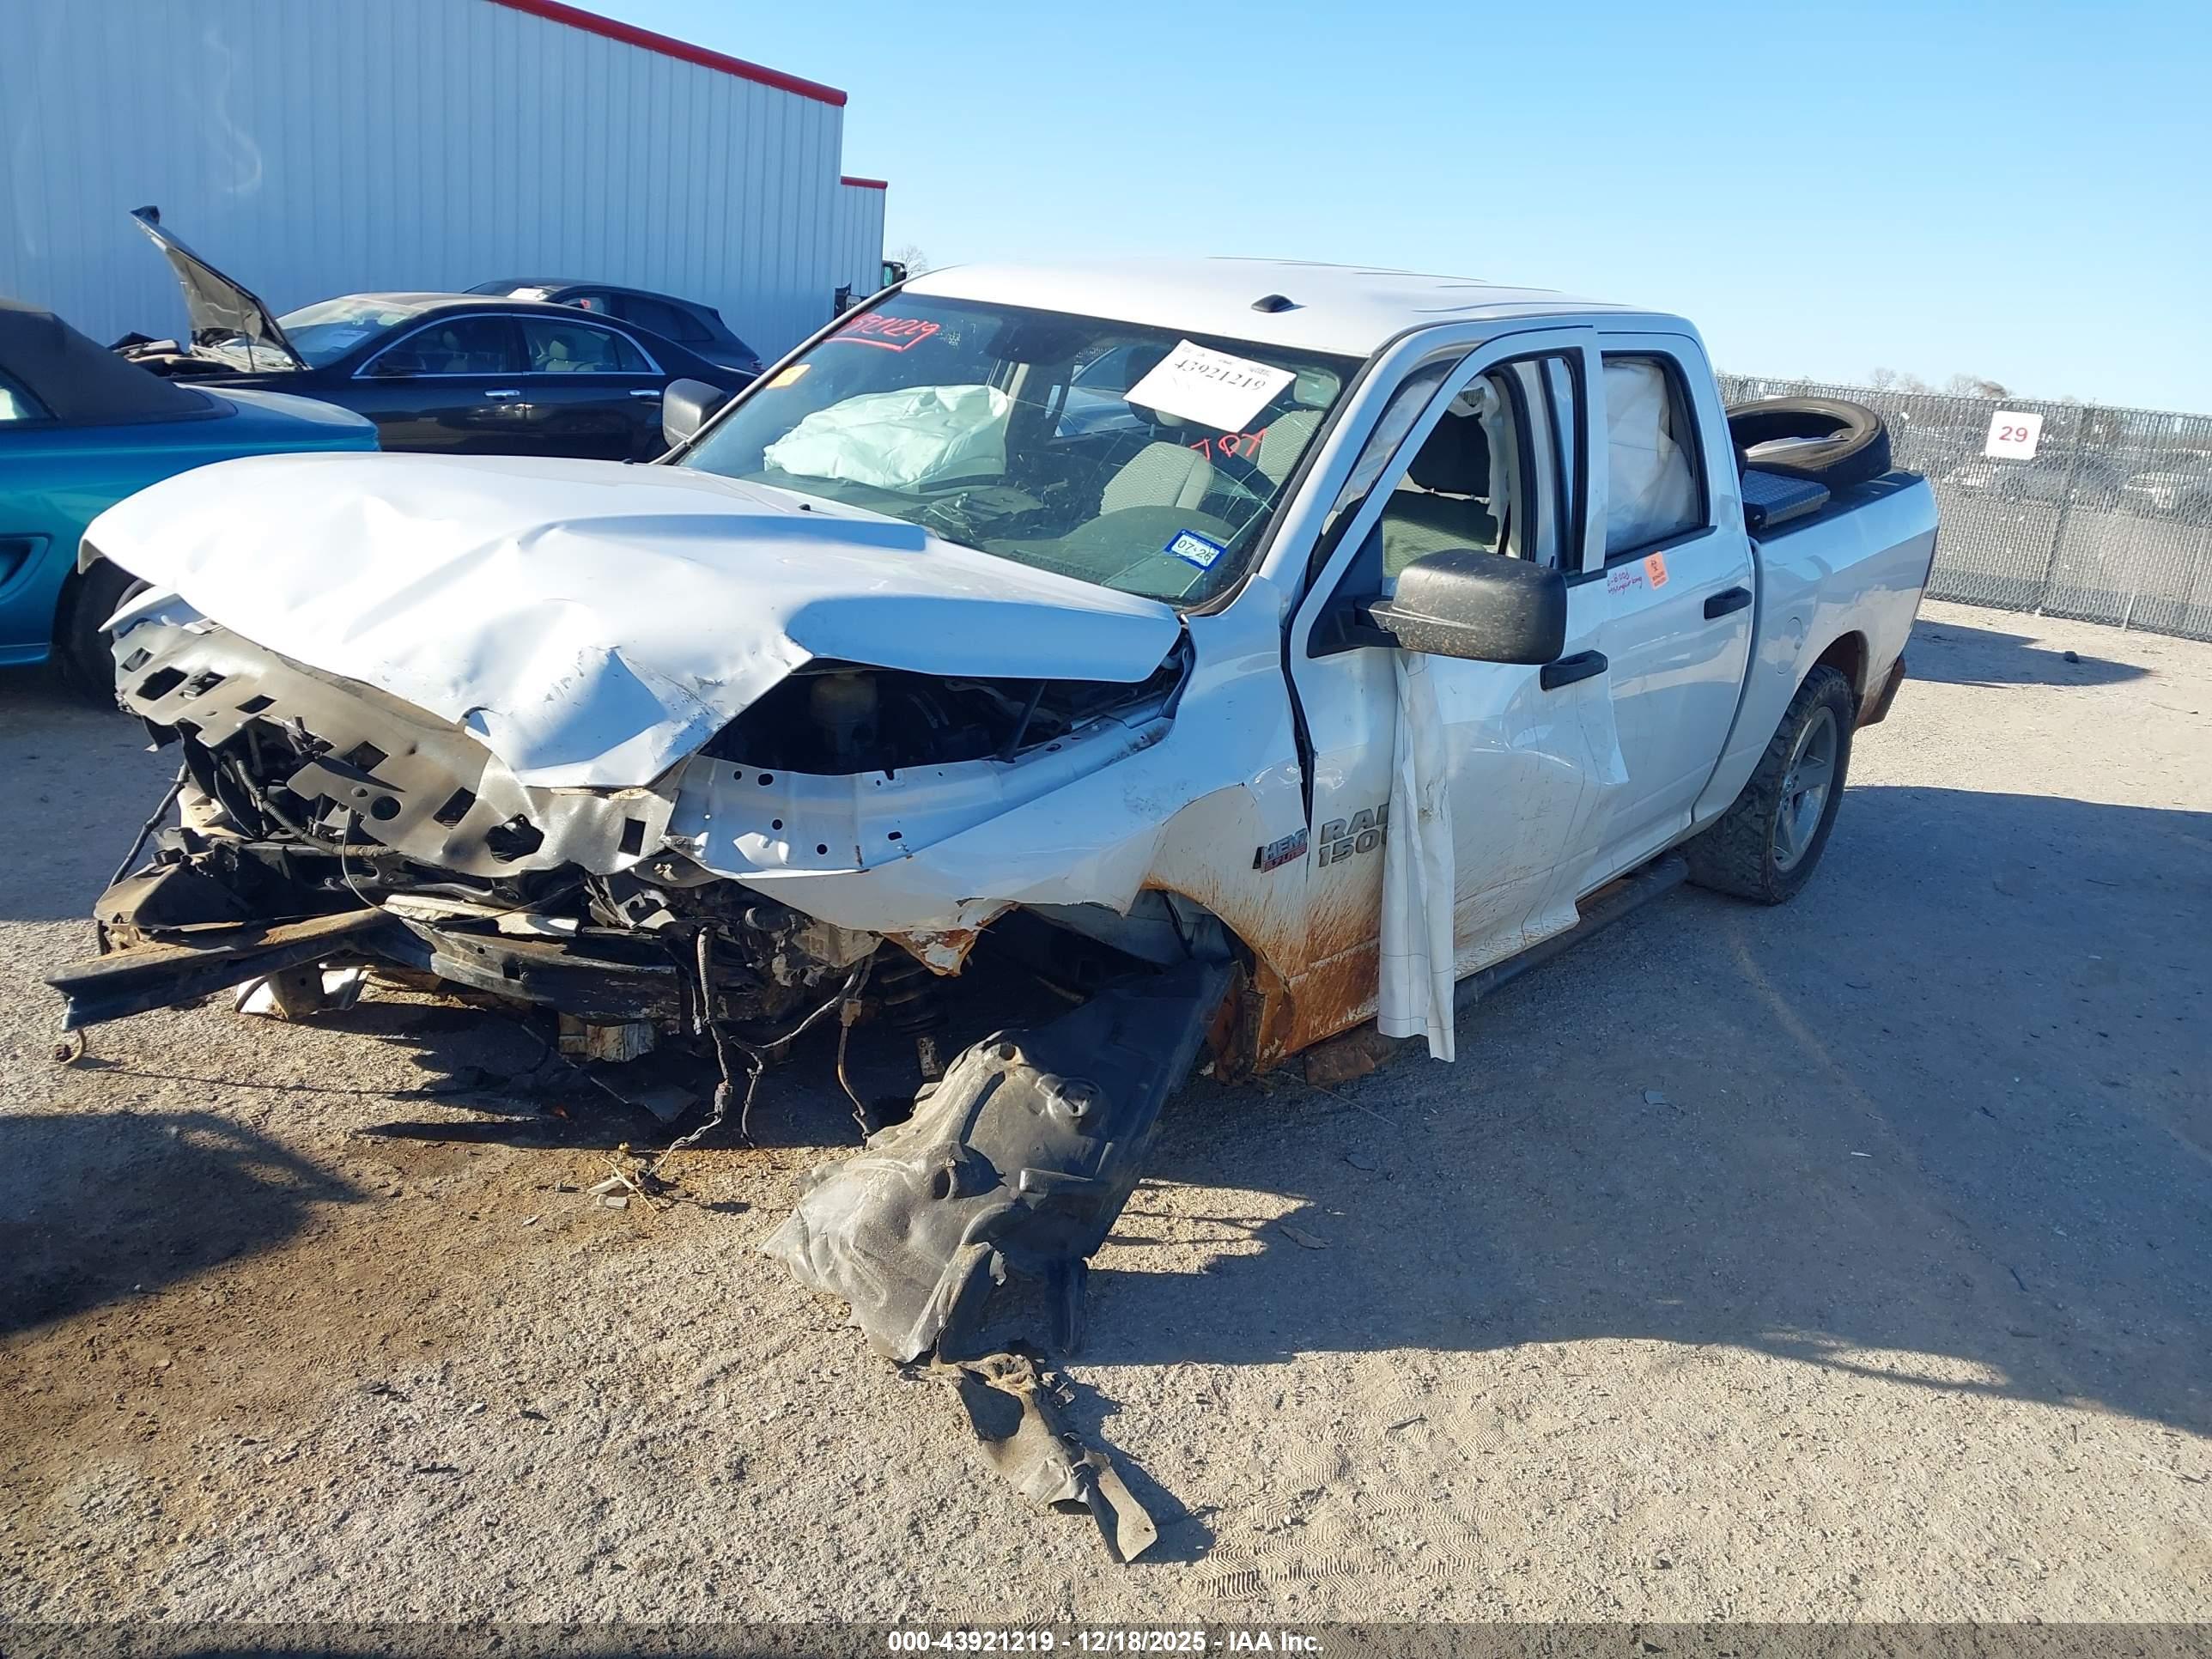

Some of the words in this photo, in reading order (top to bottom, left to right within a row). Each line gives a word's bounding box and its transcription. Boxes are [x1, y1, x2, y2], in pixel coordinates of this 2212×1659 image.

[1175, 360, 1267, 392] 43921219
[1998, 426, 2028, 443] 29
[1319, 823, 1389, 867] 150
